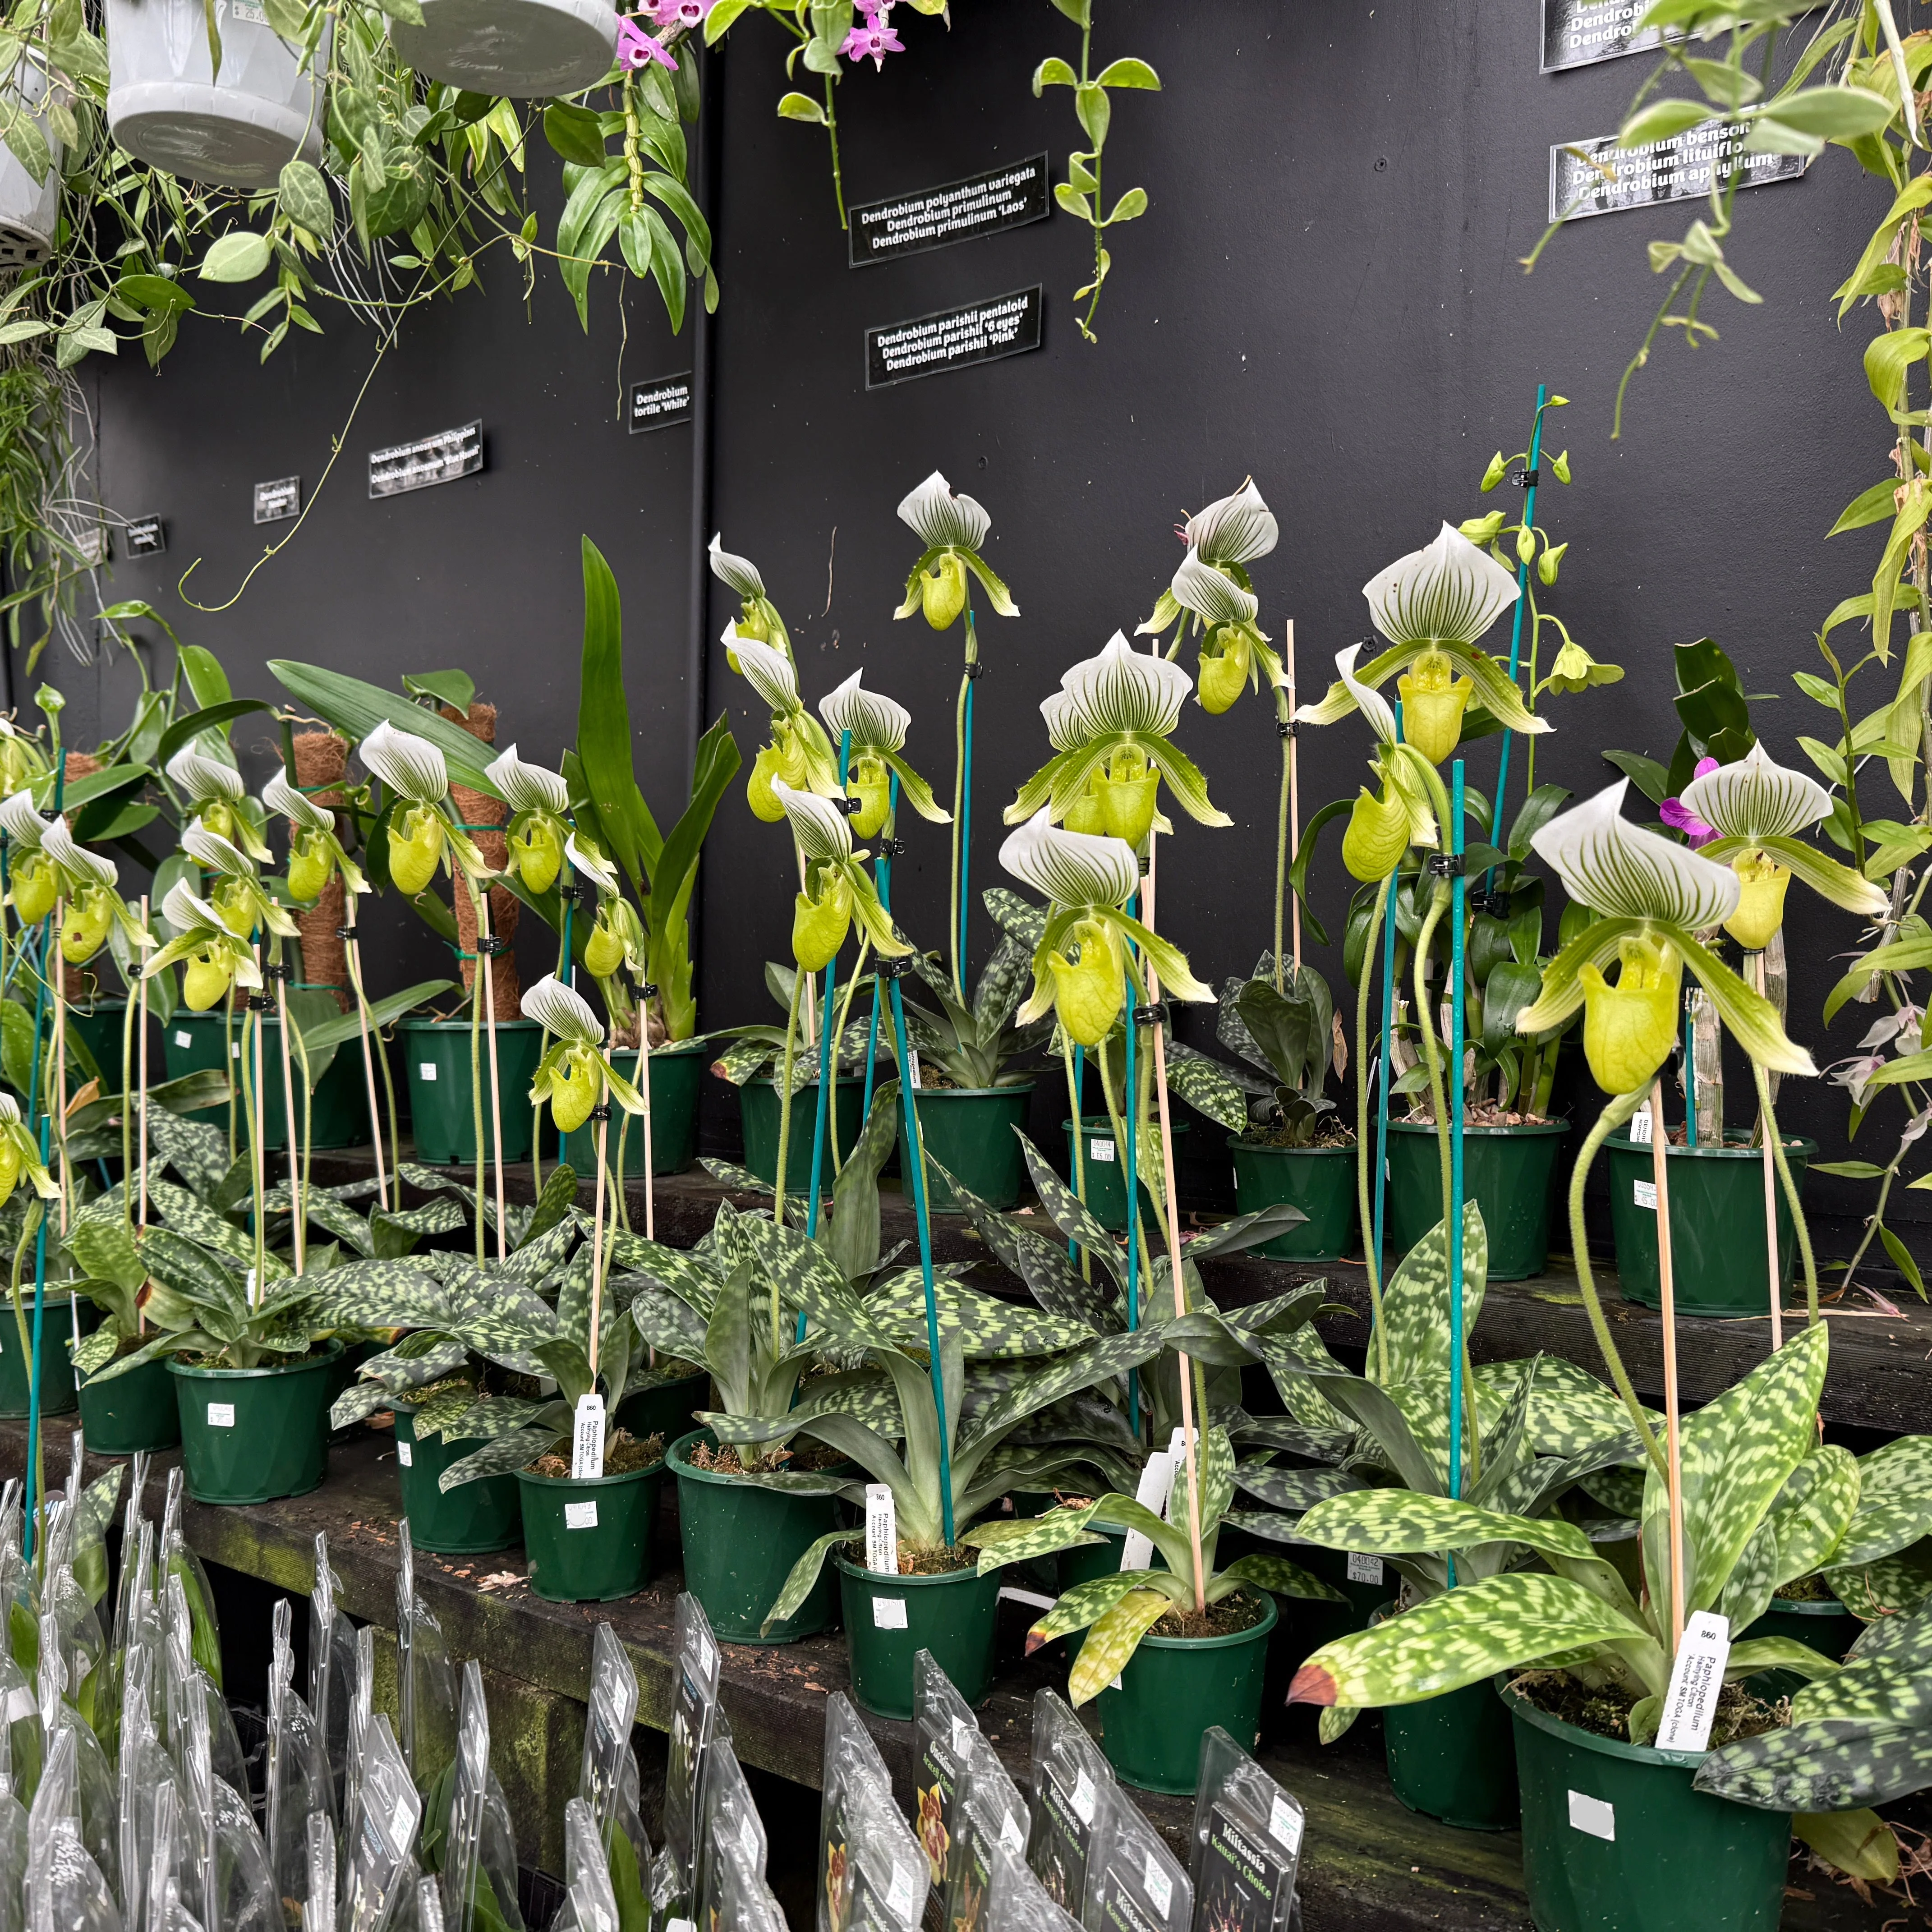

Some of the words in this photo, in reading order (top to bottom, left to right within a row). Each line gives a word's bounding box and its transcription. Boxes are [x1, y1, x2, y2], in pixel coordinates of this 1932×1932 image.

[862, 201, 924, 225] Dendrobium
[926, 183, 987, 209] polyanthum
[989, 167, 1035, 191] variegata
[1578, 170, 1685, 200] Dendrobium
[873, 225, 936, 249] Dendrobium
[938, 208, 997, 237] primulinum
[887, 209, 950, 232] Dendrobium
[952, 190, 1012, 219] primulinum
[878, 324, 937, 347] Dendrobium
[938, 310, 978, 334] parishii
[980, 295, 1028, 324] pentaloid
[883, 336, 942, 359] Dendrobium
[943, 323, 983, 347] parishii
[886, 348, 947, 372] Dendrobium
[948, 336, 987, 360] parishii
[634, 404, 661, 417] tortile
[636, 386, 688, 405] Dendrobium
[590, 1421, 598, 1470] Paphiopedilum
[1353, 1572, 1378, 1584] $70.00
[1674, 1696, 1685, 1721] TOGA
[1679, 1686, 1688, 1696] SM
[1686, 1685, 1697, 1707] Citron
[1691, 1656, 1716, 1731] Paphiopedilum
[1667, 1719, 1679, 1743] (clone)
[1050, 1782, 1080, 1835] Miltassia
[1064, 1825, 1085, 1860] Choice
[1223, 1822, 1265, 1874] Miltassia
[1212, 1834, 1241, 1871] Kauai's
[1242, 1865, 1272, 1901] Choice
